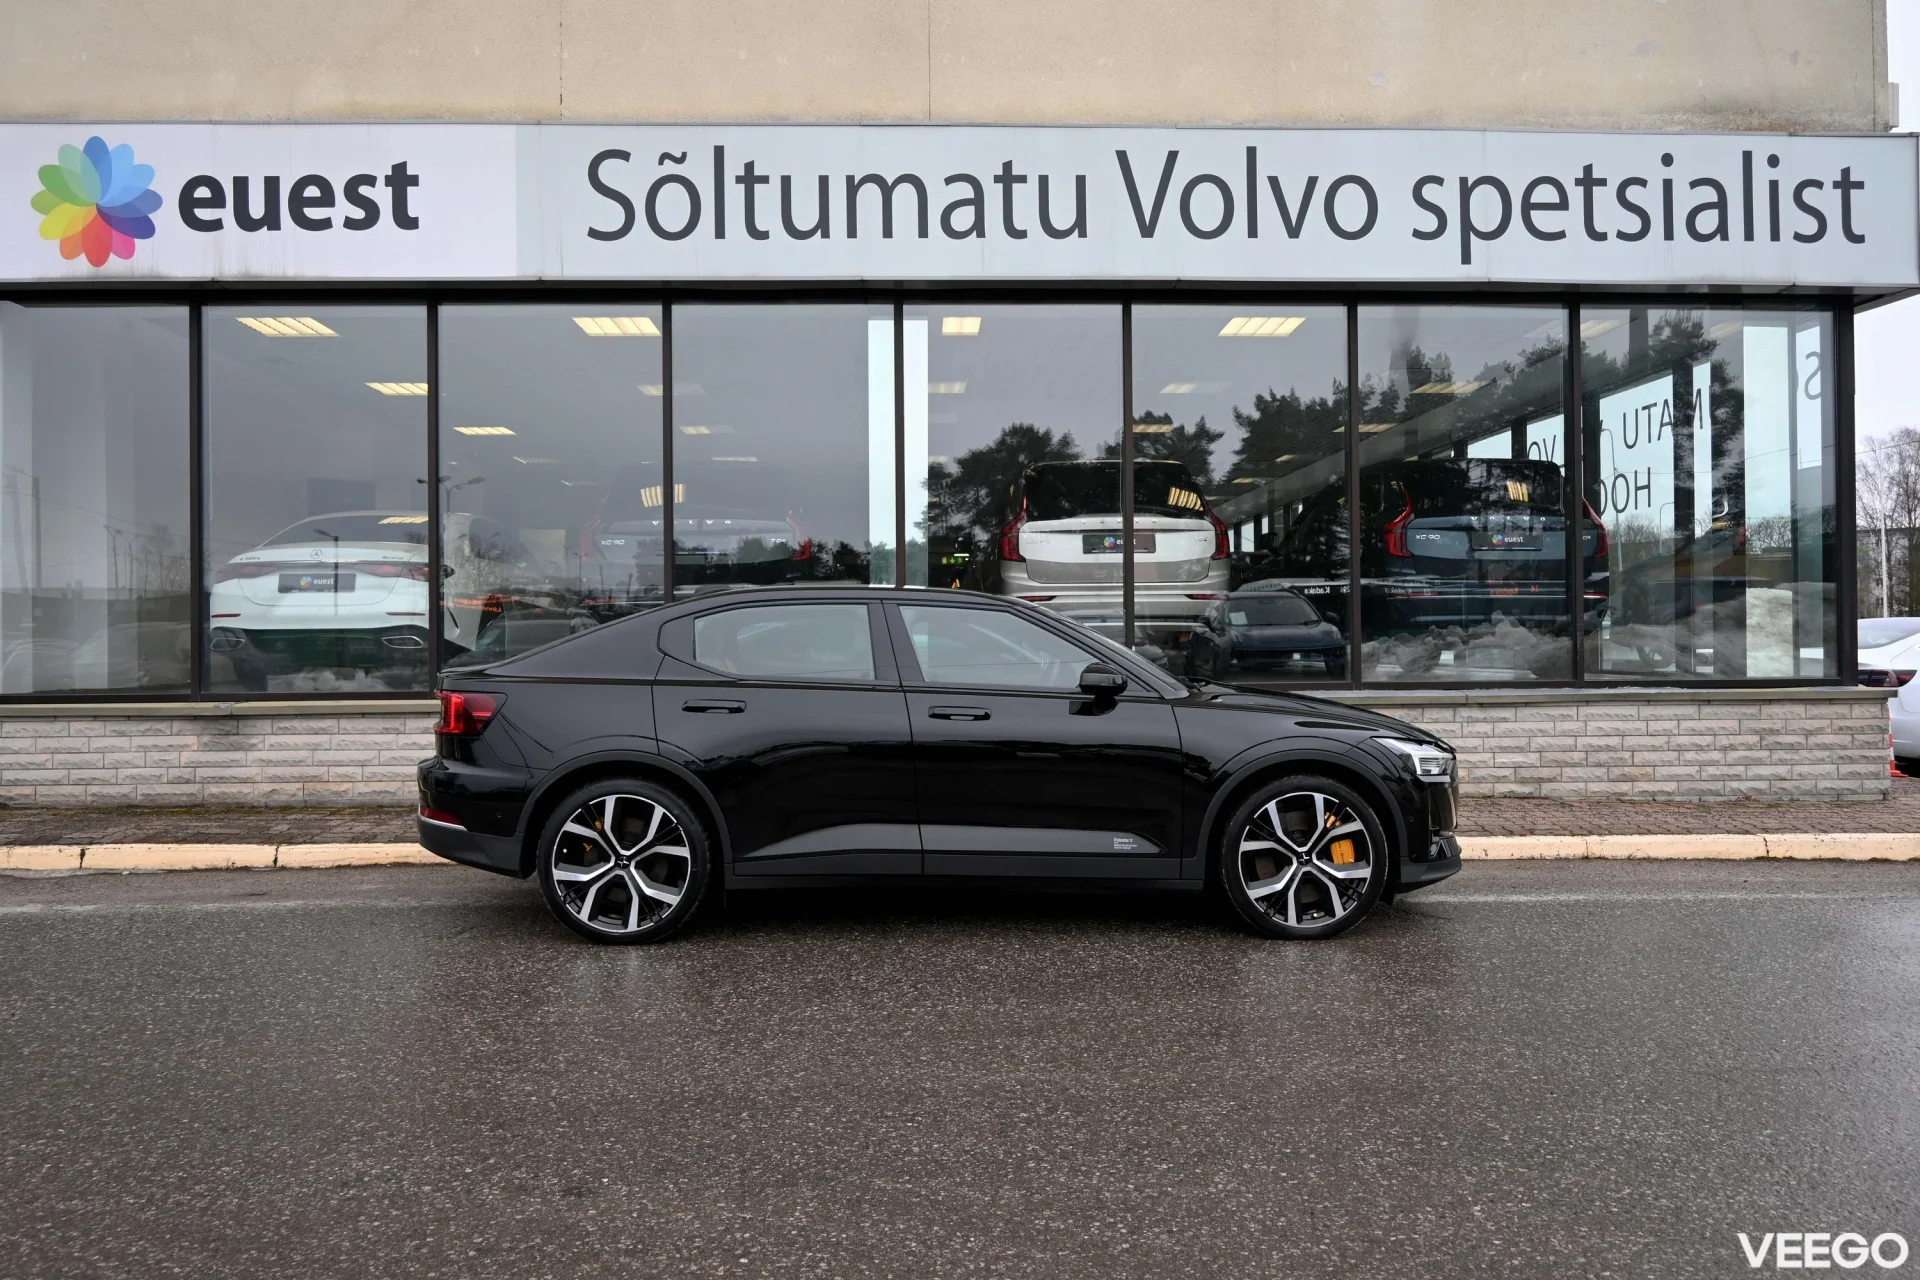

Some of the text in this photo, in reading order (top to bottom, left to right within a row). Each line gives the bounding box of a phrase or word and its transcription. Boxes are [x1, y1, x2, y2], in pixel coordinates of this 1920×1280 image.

[179, 160, 420, 233] euest
[587, 145, 1867, 265] Sõltumatu Volvo spetsialist
[313, 577, 335, 585] euest
